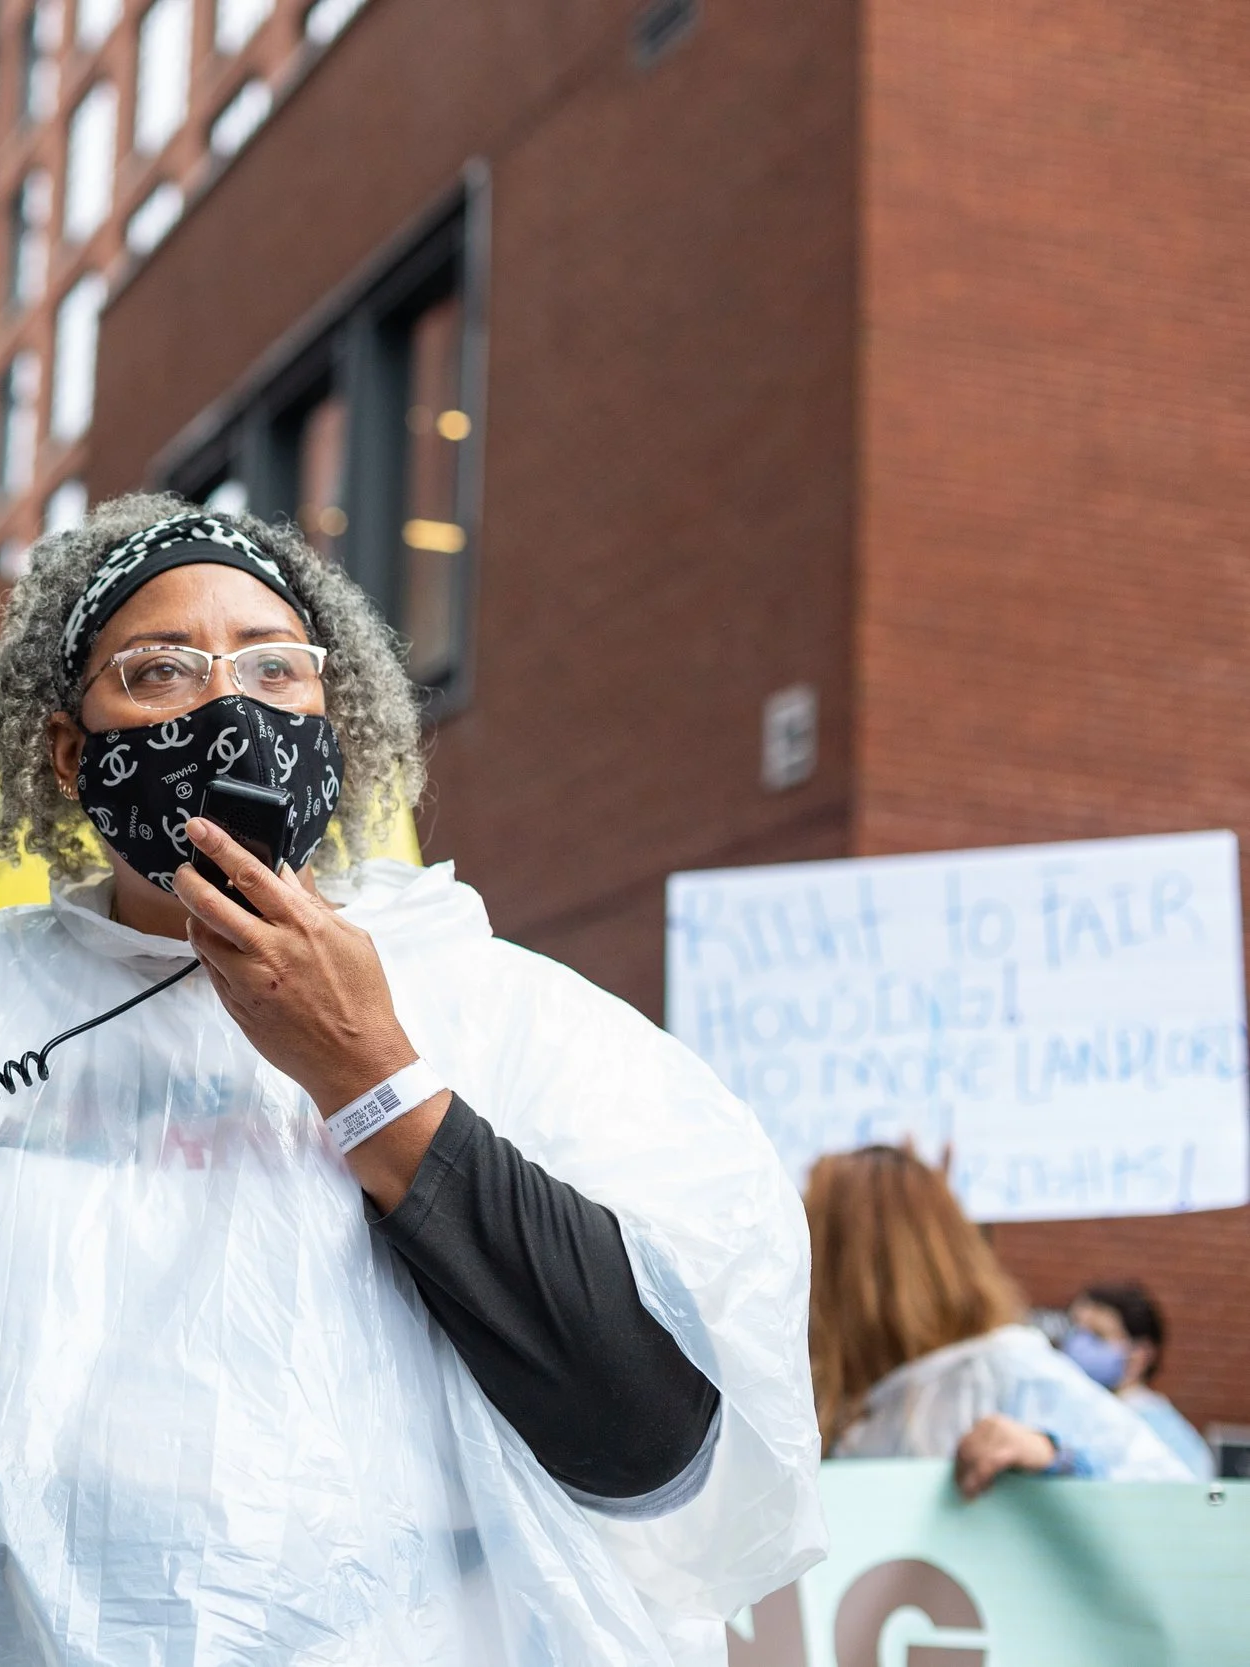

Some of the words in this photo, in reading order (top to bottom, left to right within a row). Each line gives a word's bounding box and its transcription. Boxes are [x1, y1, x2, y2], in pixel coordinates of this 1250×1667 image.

[160, 762, 199, 786] CHANEL
[126, 804, 140, 840] CHANEL
[302, 784, 313, 825] CHANEL
[1038, 859, 1210, 972] FAIR
